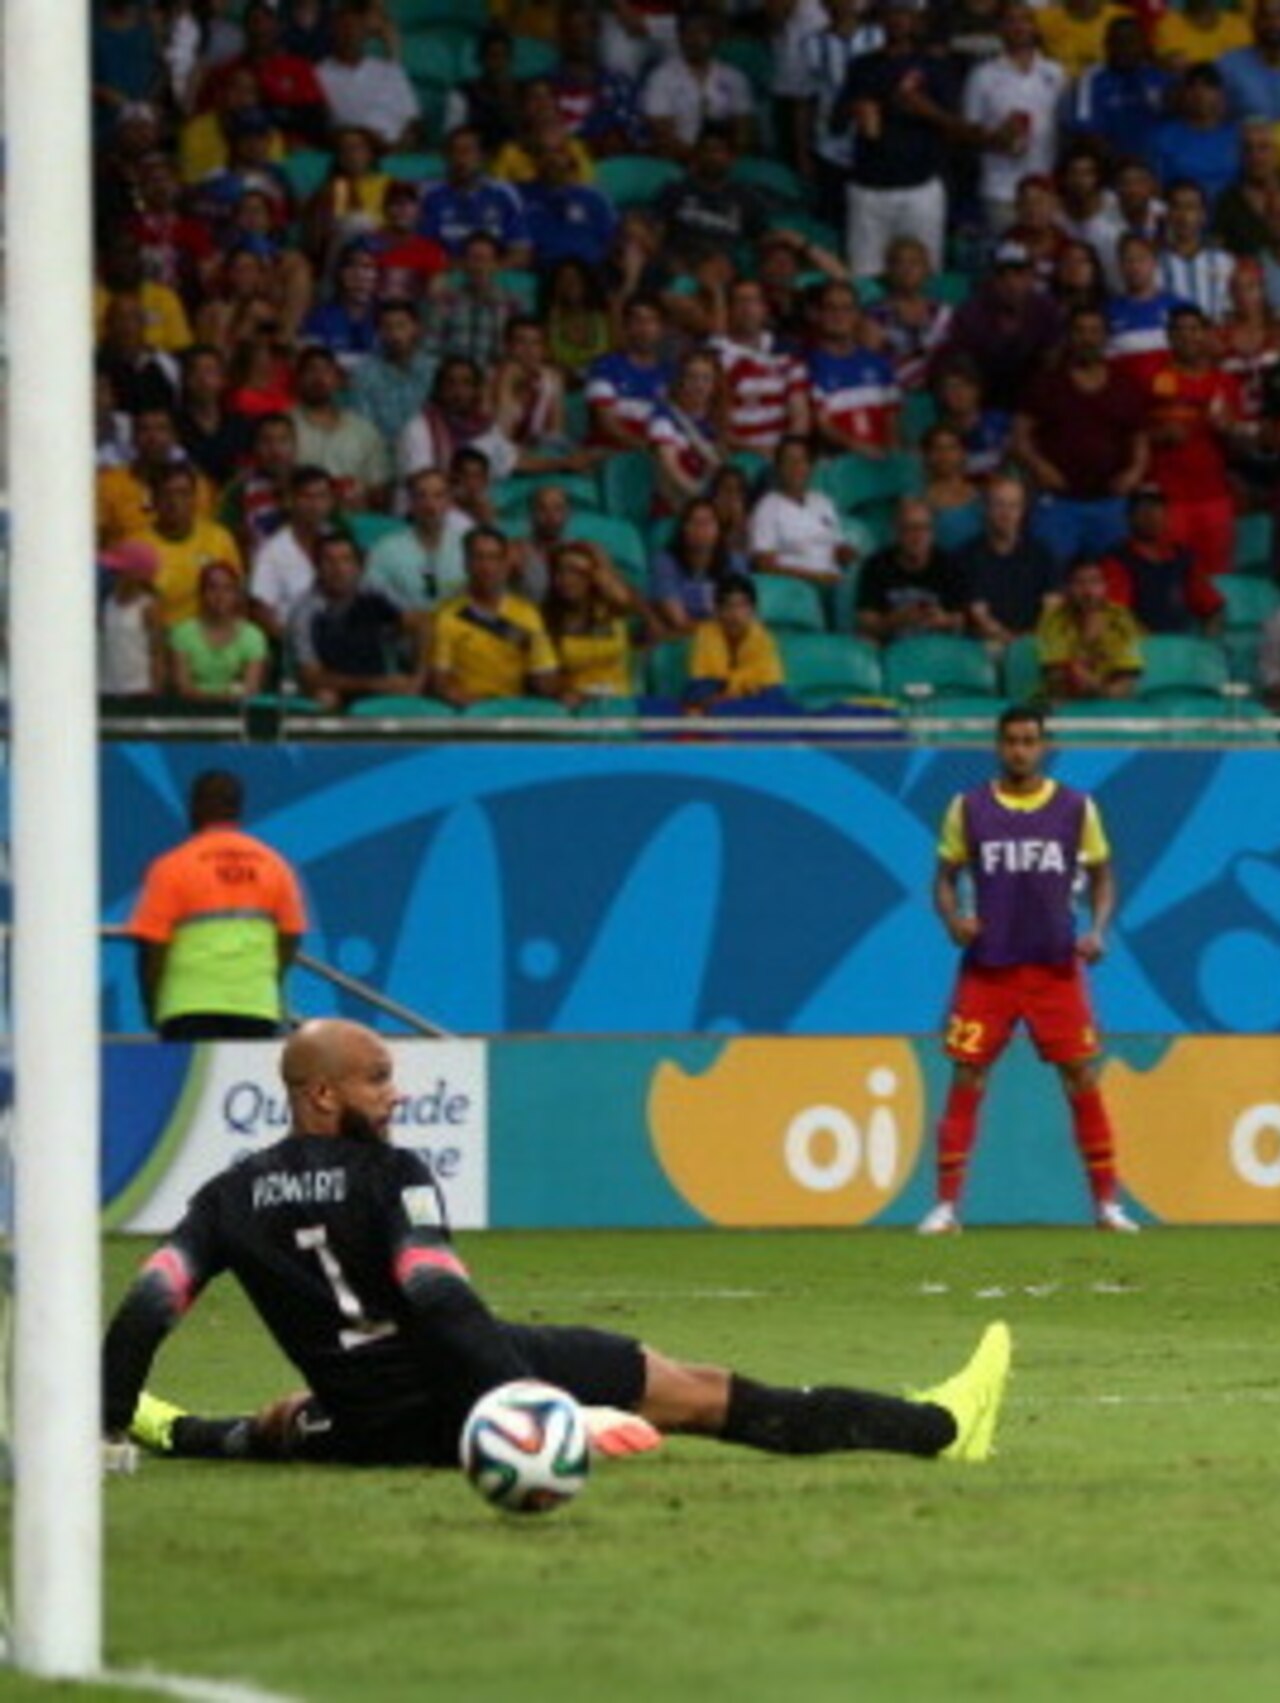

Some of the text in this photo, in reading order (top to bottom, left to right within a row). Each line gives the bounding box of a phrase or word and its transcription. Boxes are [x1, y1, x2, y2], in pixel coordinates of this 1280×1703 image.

[980, 840, 1066, 874] FIFA
[946, 1014, 984, 1054] 22
[785, 1066, 897, 1191] oi
[295, 1223, 397, 1350] 1
